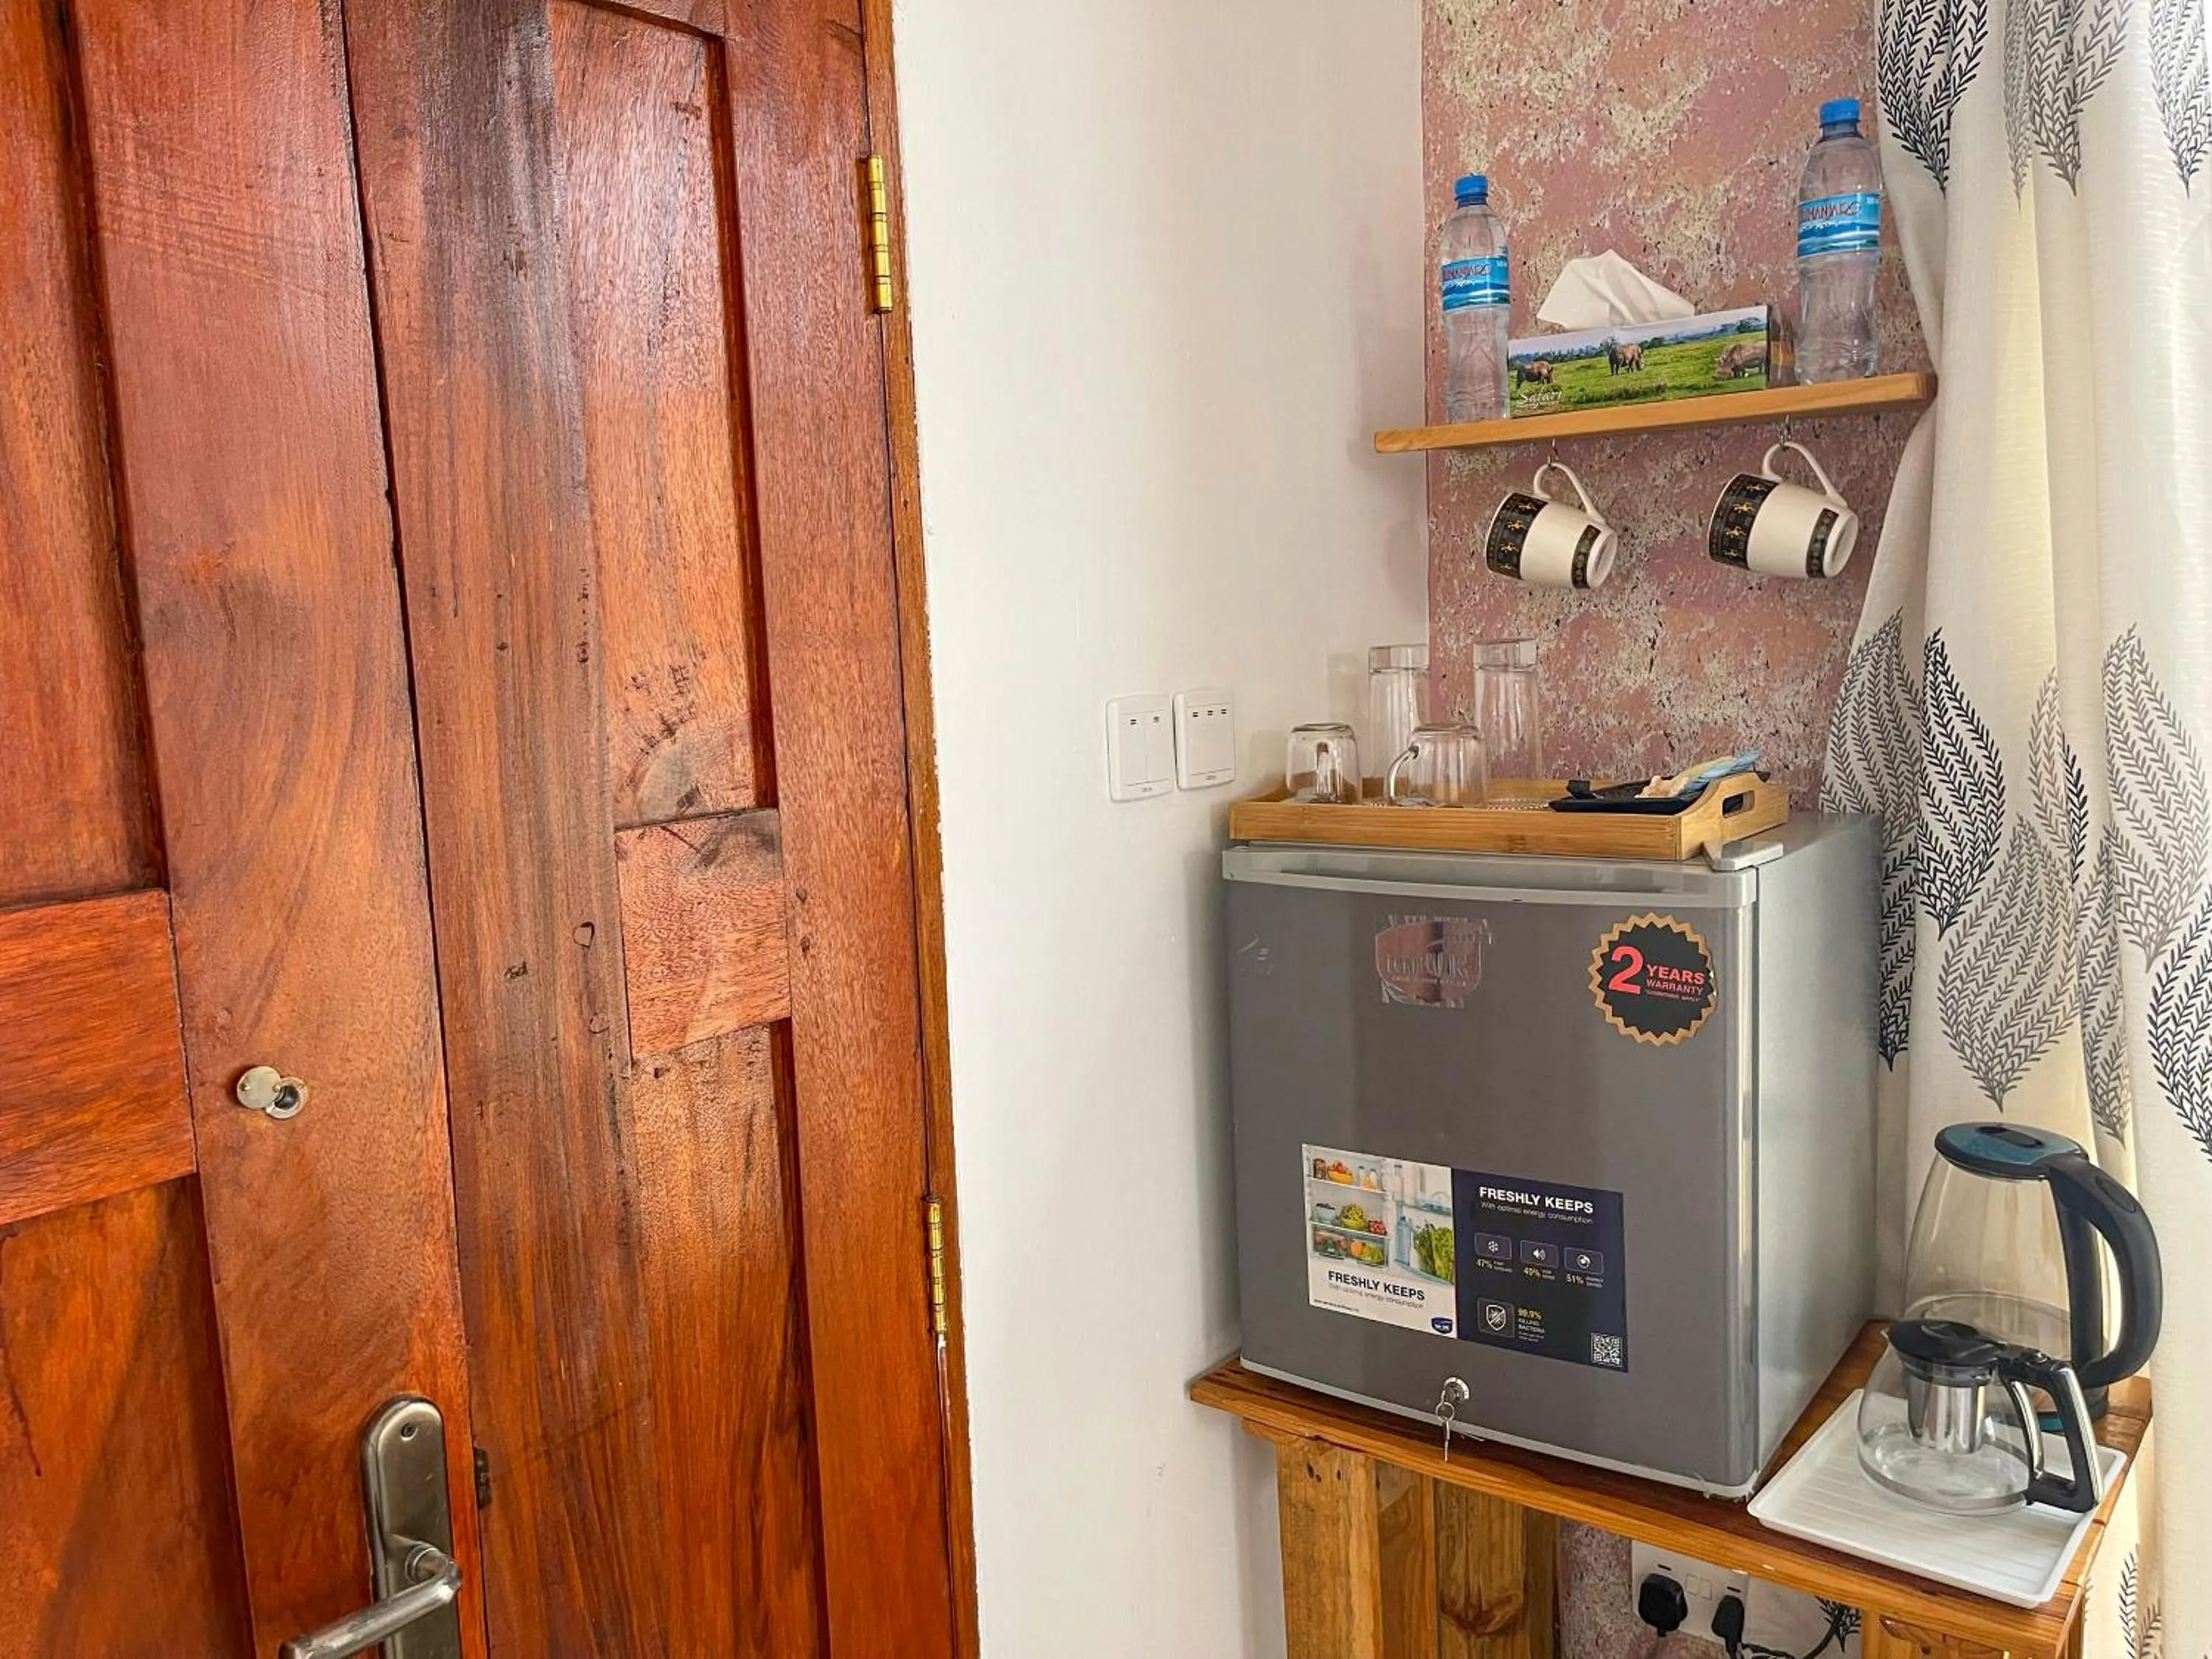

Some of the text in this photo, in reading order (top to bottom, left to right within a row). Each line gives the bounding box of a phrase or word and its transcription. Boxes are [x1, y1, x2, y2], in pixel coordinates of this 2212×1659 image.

[1608, 946, 1705, 995] 2 YEARS
[1646, 978, 1703, 996] WARRANTY
[1479, 1186, 1593, 1214] FRESHLY KEEPS
[1547, 1212, 1593, 1225] consumption
[1328, 1270, 1425, 1301] FRESHLY KEEPS
[1566, 1273, 1584, 1284] 51%
